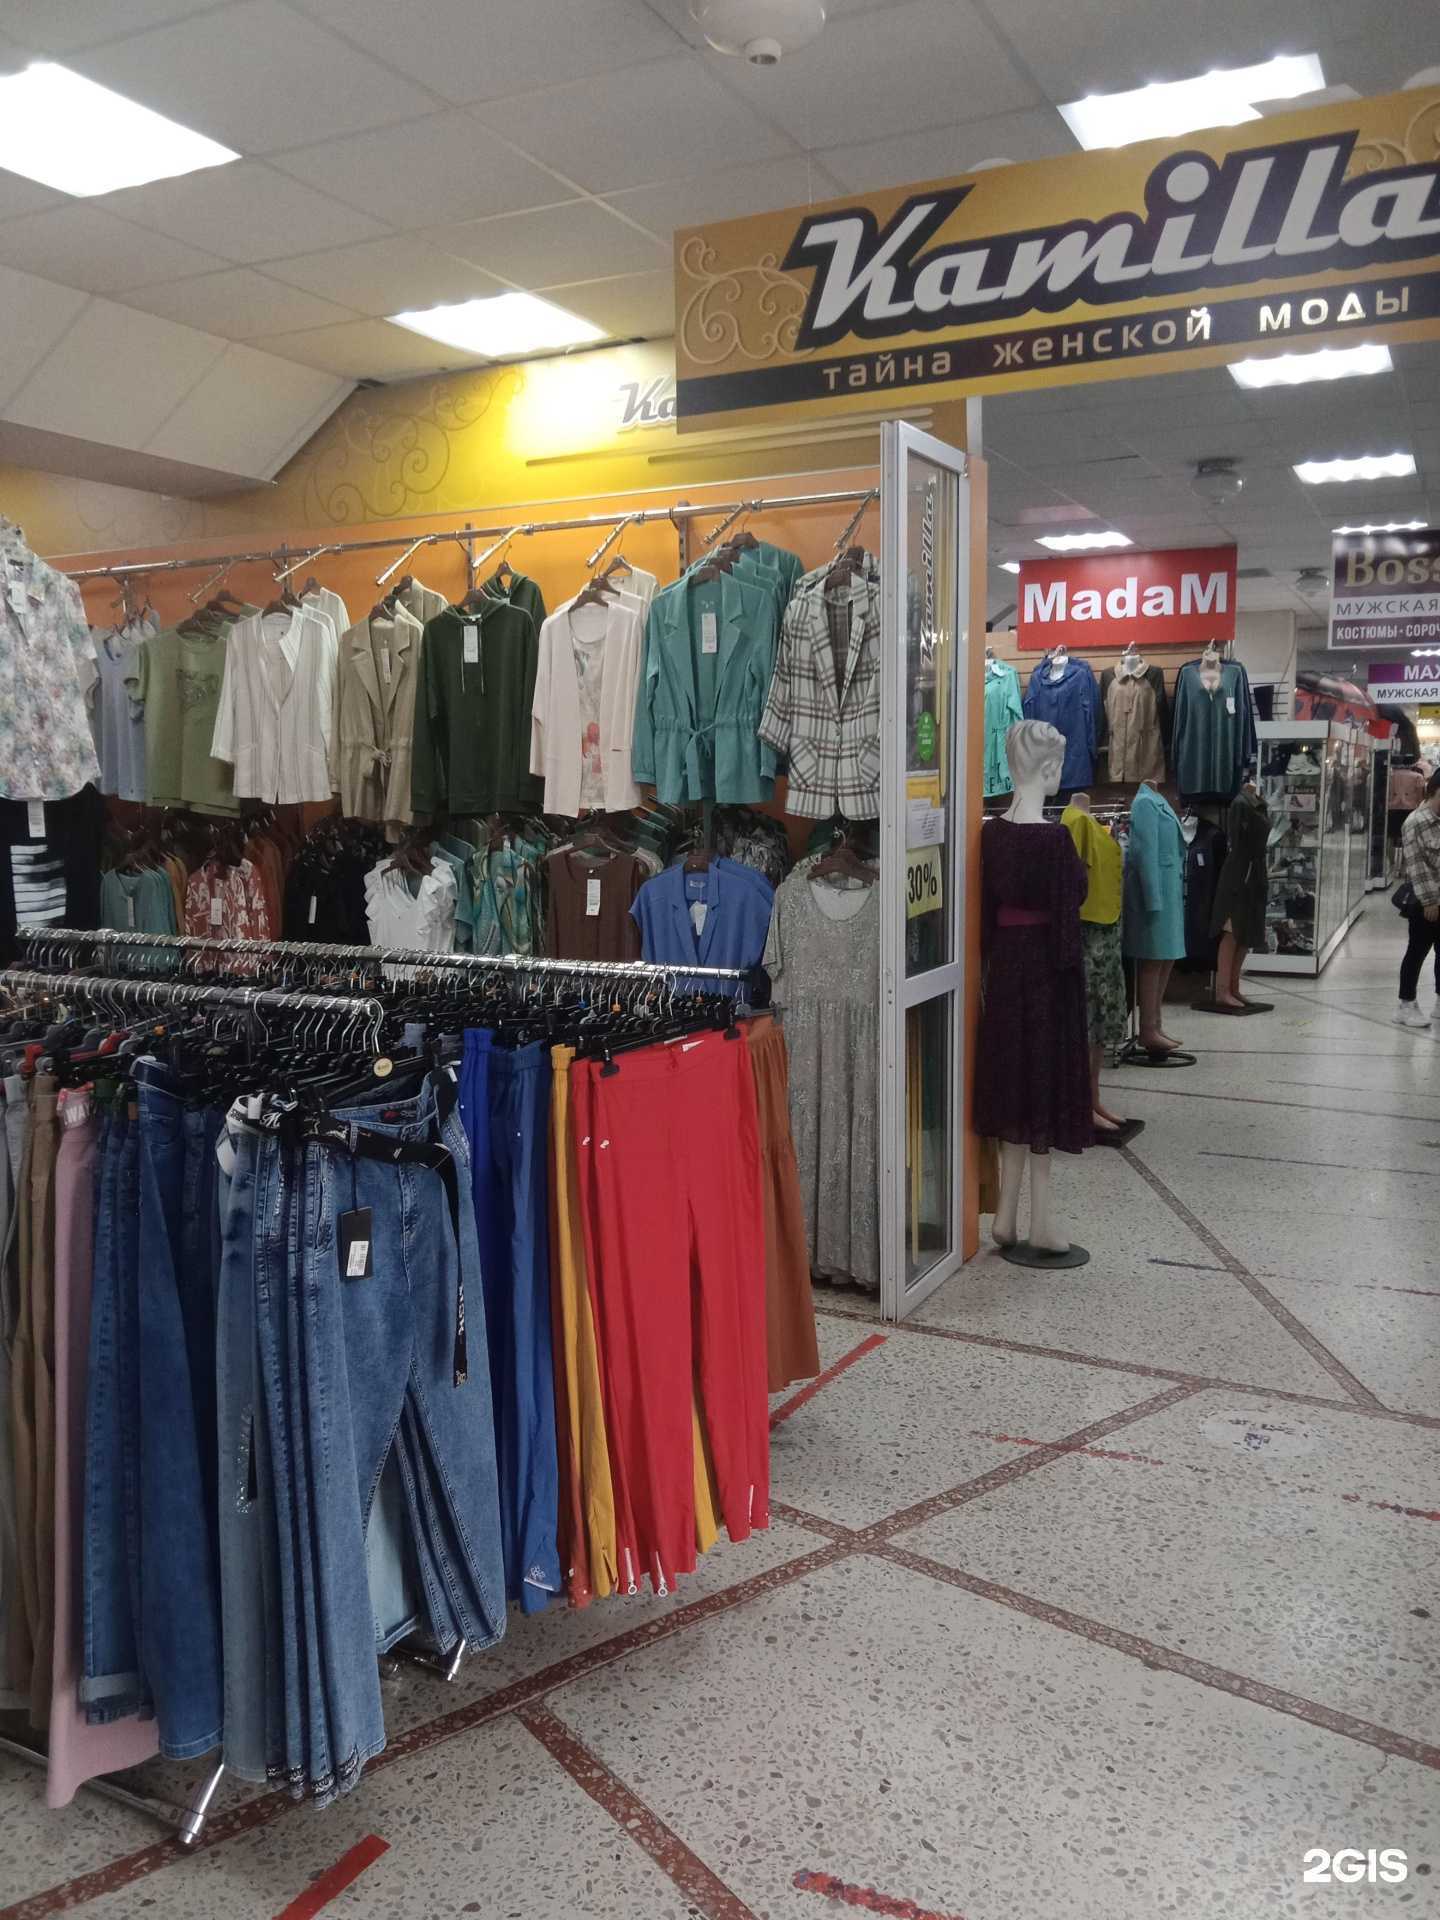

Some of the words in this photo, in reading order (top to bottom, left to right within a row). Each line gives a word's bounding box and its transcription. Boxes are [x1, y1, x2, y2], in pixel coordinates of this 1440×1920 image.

[802, 144, 1440, 329] Kamilla
[822, 350, 953, 391] тайна
[992, 308, 1212, 367] женской
[1259, 286, 1409, 333] моды
[1022, 572, 1229, 624] MadaM
[1336, 599, 1439, 615] МУЖСКАЯ
[1336, 624, 1398, 640] КОСТЮМЫ
[1377, 687, 1439, 699] МУЖСКАЯ
[907, 862, 938, 904] 30%
